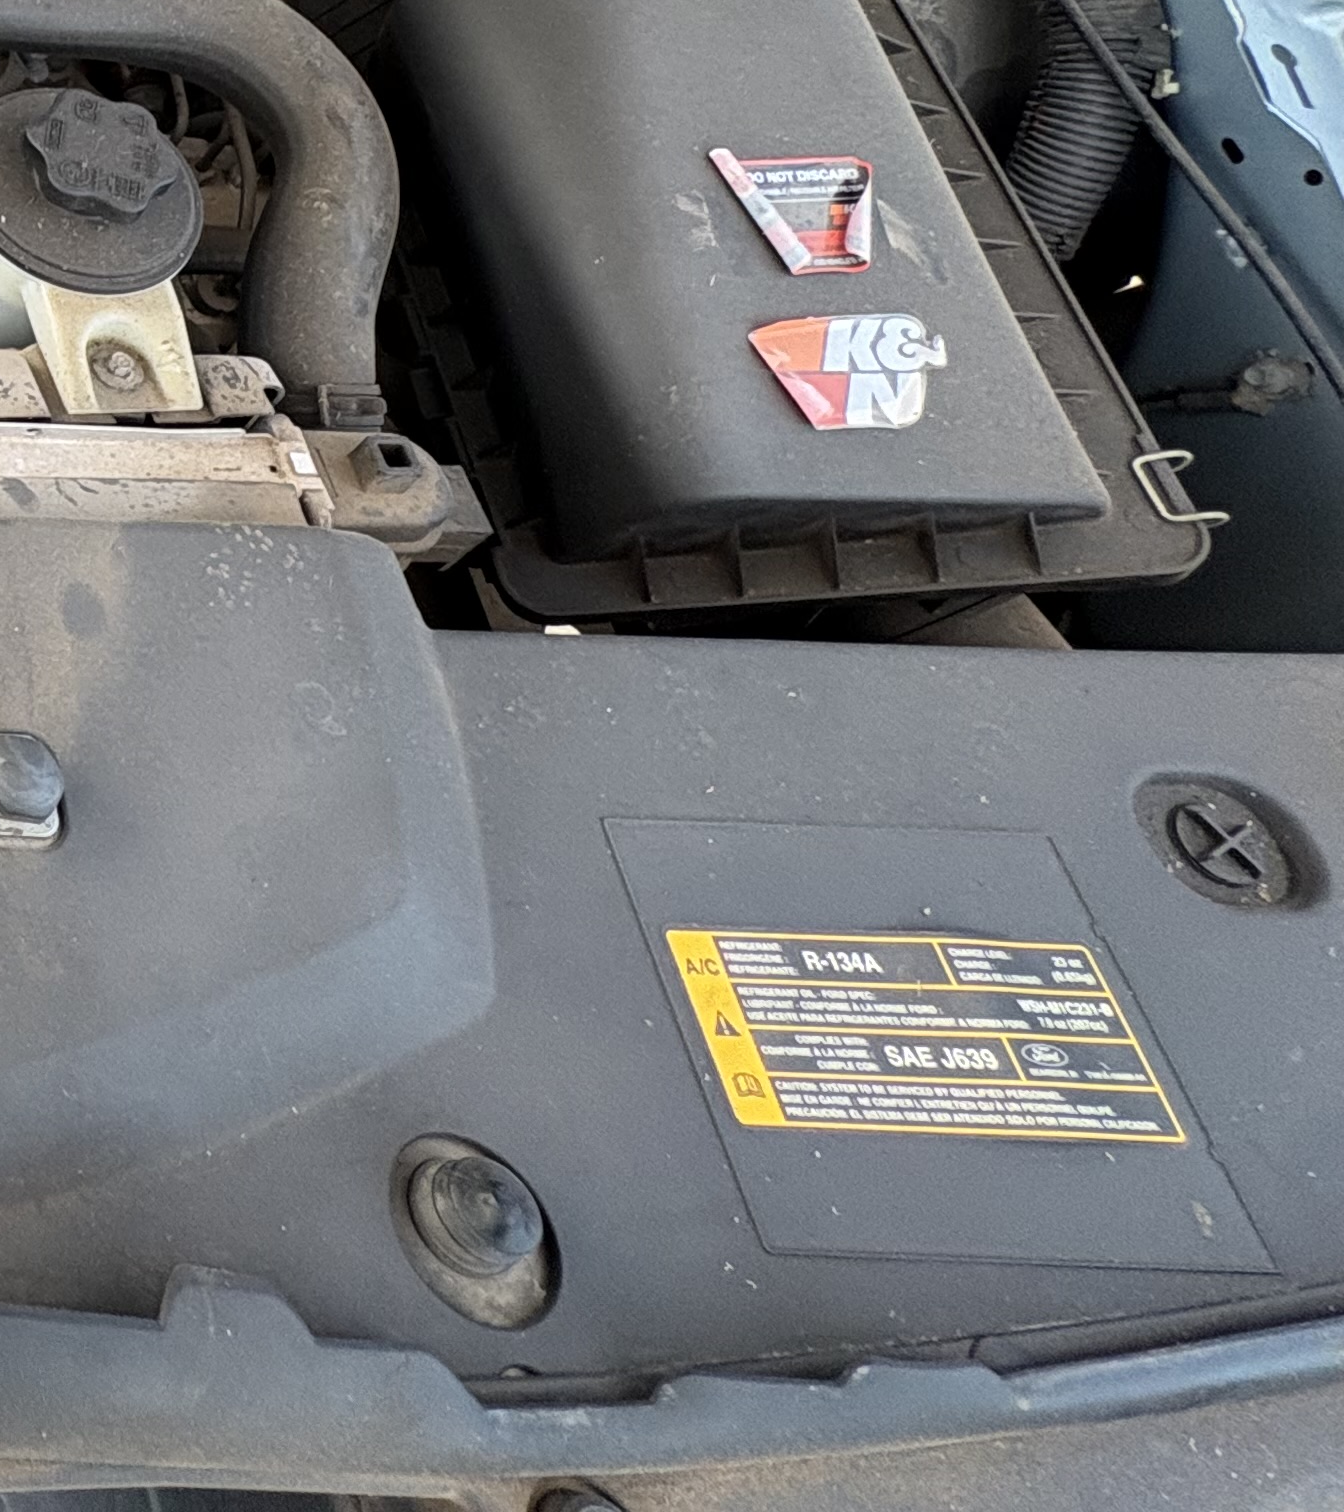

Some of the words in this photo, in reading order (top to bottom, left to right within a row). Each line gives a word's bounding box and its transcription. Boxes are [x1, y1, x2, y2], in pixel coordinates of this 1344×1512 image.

[766, 169, 794, 184] NOT
[795, 167, 860, 182] DISCARD
[684, 957, 721, 976] A/C
[800, 950, 884, 973] R-134A
[882, 1045, 938, 1068] SAE
[935, 1047, 1001, 1070] J639
